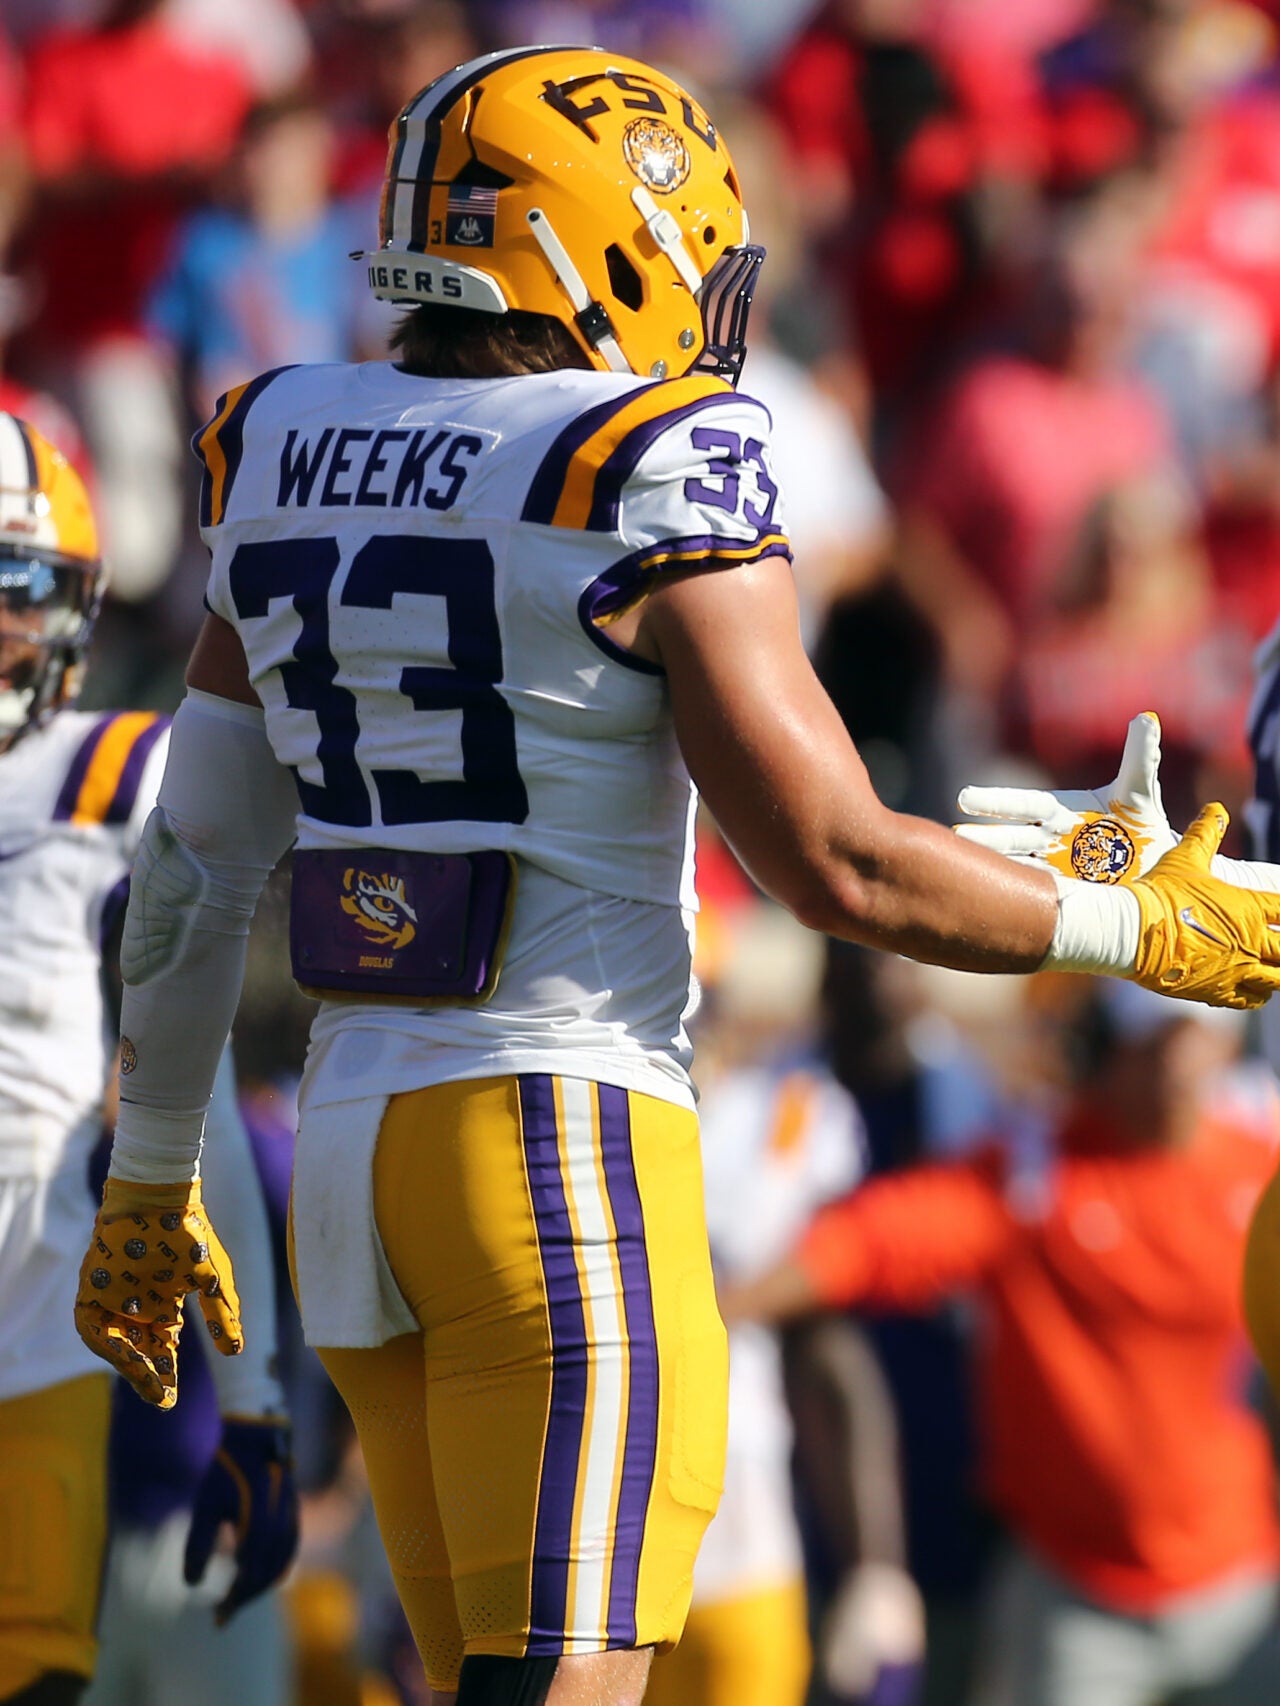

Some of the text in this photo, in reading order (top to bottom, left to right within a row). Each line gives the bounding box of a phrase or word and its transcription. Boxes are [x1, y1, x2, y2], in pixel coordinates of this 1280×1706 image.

[541, 72, 717, 152] LSU
[276, 426, 483, 512] WEEKS
[684, 427, 778, 531] 33
[228, 533, 530, 828] 33
[156, 1240, 179, 1264] LSU
